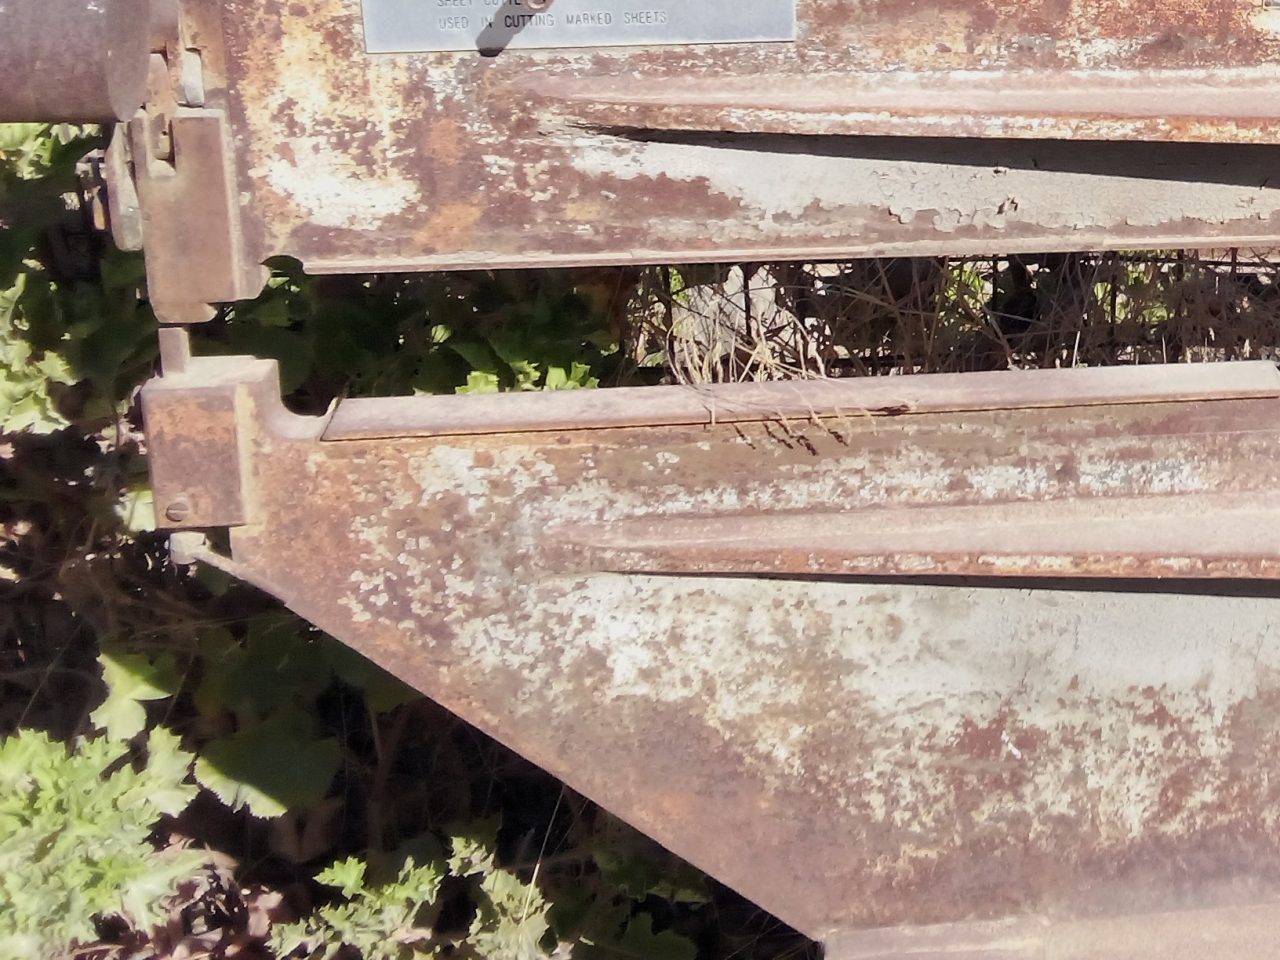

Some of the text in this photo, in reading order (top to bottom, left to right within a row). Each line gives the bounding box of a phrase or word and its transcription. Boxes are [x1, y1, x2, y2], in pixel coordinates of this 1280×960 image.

[438, 10, 667, 30] USED IN CUTTING MARKED SHEETS
